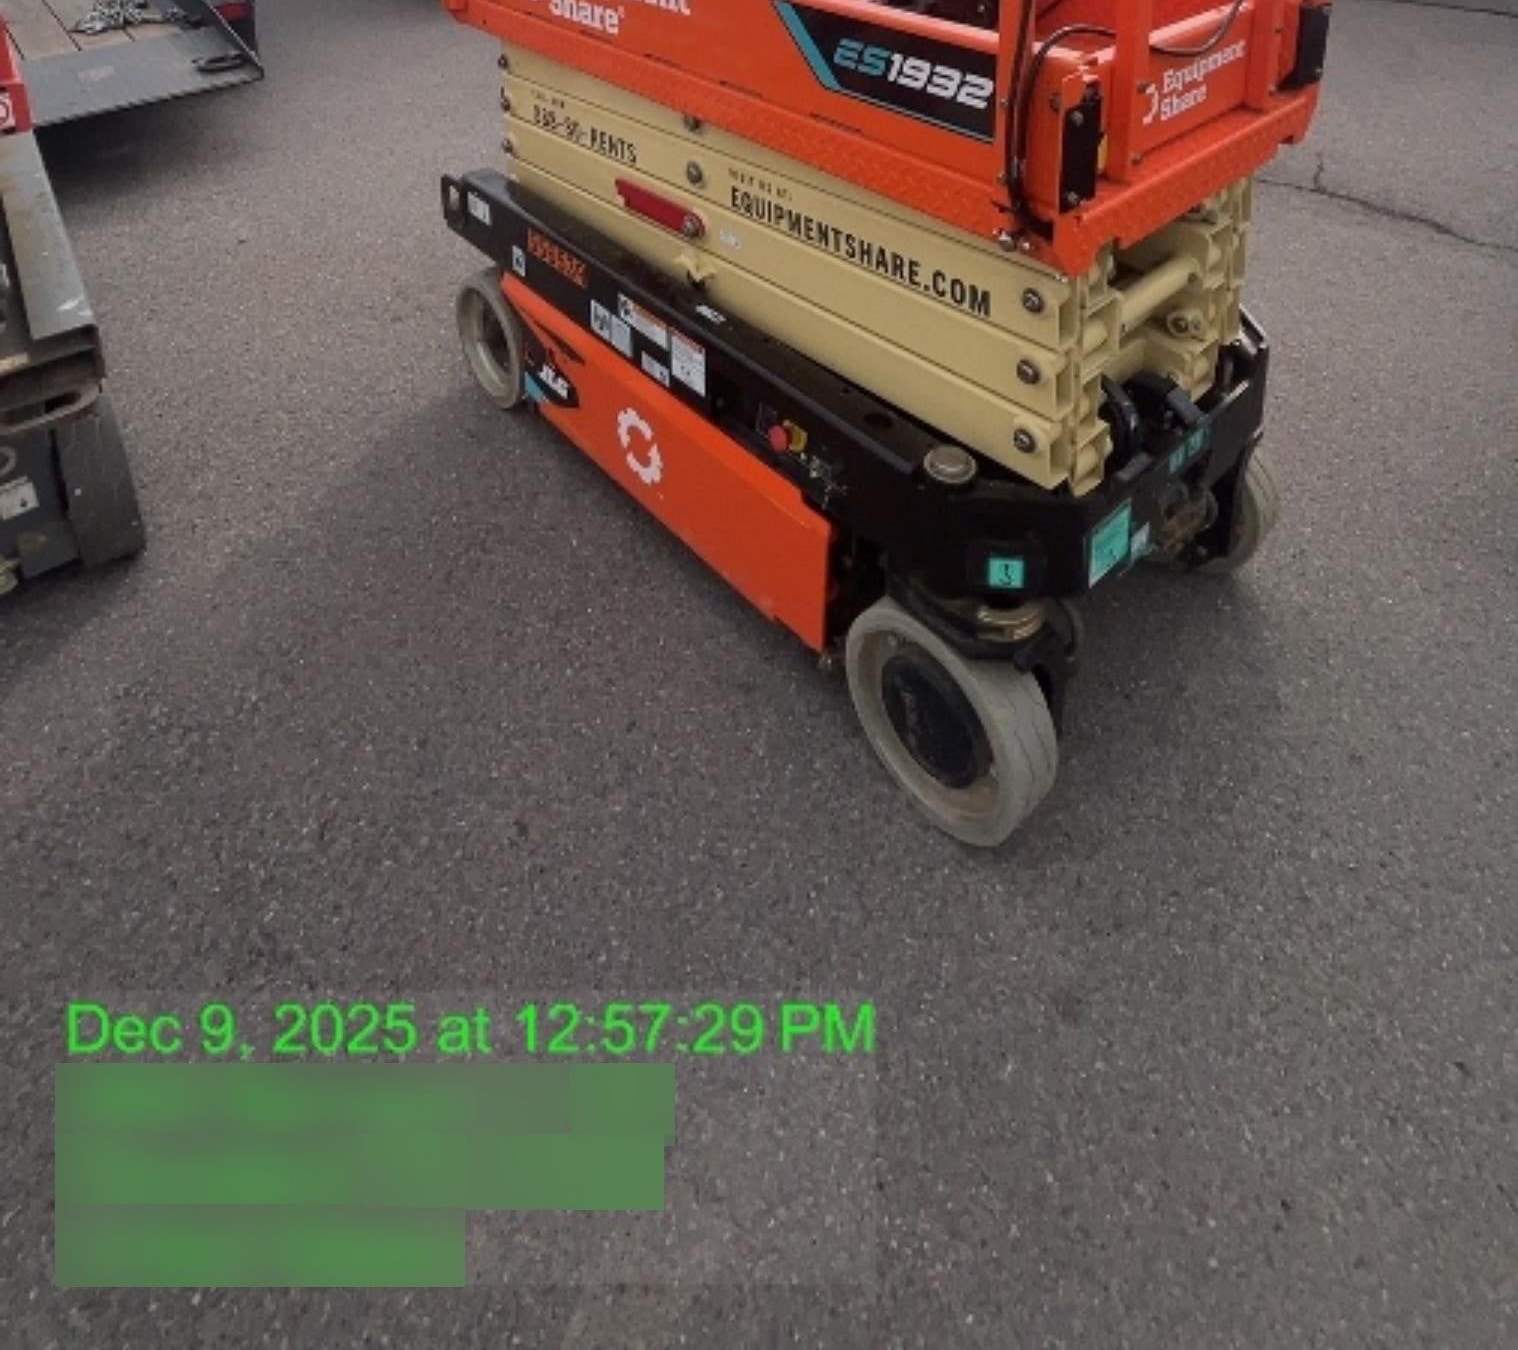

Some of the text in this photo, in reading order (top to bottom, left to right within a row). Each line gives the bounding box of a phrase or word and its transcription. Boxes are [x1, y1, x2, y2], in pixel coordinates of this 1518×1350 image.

[833, 37, 994, 110] ES1932
[1163, 38, 1246, 93] Equipment
[731, 185, 991, 318] EQUIPMENTSHARE.COM
